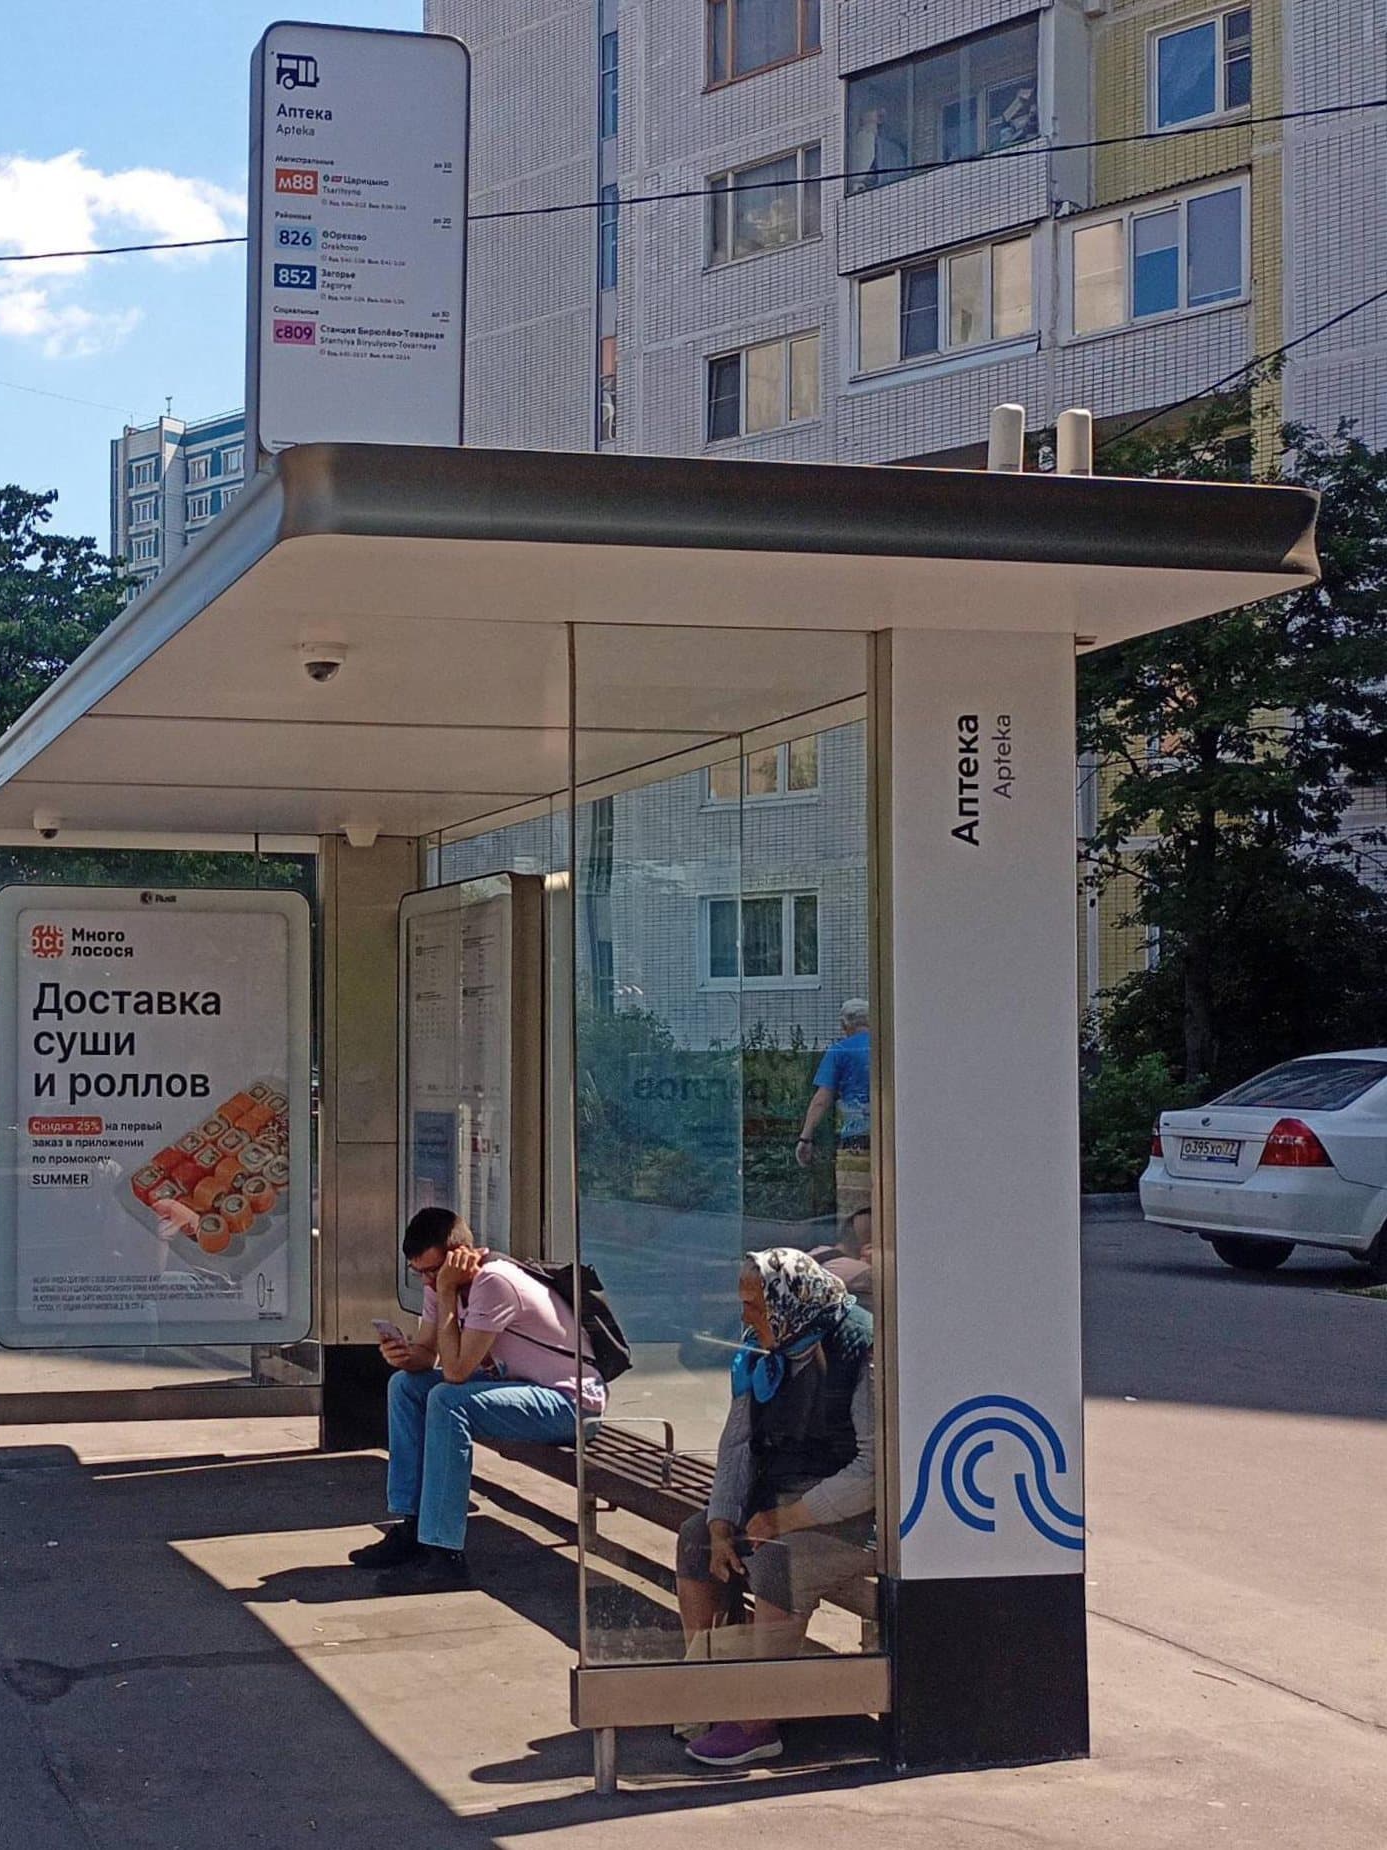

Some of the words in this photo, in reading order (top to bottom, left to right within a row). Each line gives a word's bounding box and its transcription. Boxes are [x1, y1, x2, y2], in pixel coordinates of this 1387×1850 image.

[276, 103, 333, 121] Аптека
[276, 123, 316, 137] Apteka
[278, 173, 315, 191] м88
[279, 229, 312, 247] 826
[278, 268, 311, 285] 852
[275, 325, 313, 340] с809
[320, 324, 356, 335] Станция
[991, 714, 1016, 800] Apteka
[951, 714, 980, 847] Аптека
[72, 927, 125, 944] Много
[71, 945, 134, 958] лосося
[32, 982, 222, 1020] Доставка
[32, 1030, 136, 1063] суши
[33, 1073, 56, 1097] и
[69, 1072, 211, 1104] роллов
[32, 1120, 74, 1133] Скидка
[77, 1121, 101, 1132] 25%
[105, 1122, 119, 1131] на
[120, 1120, 163, 1133] первый
[32, 1138, 64, 1148] заказ
[66, 1138, 73, 1148] в
[74, 1138, 145, 1150] приложении
[32, 1154, 46, 1164] по
[48, 1154, 111, 1166] промокоду
[31, 1173, 89, 1185] SUMMER
